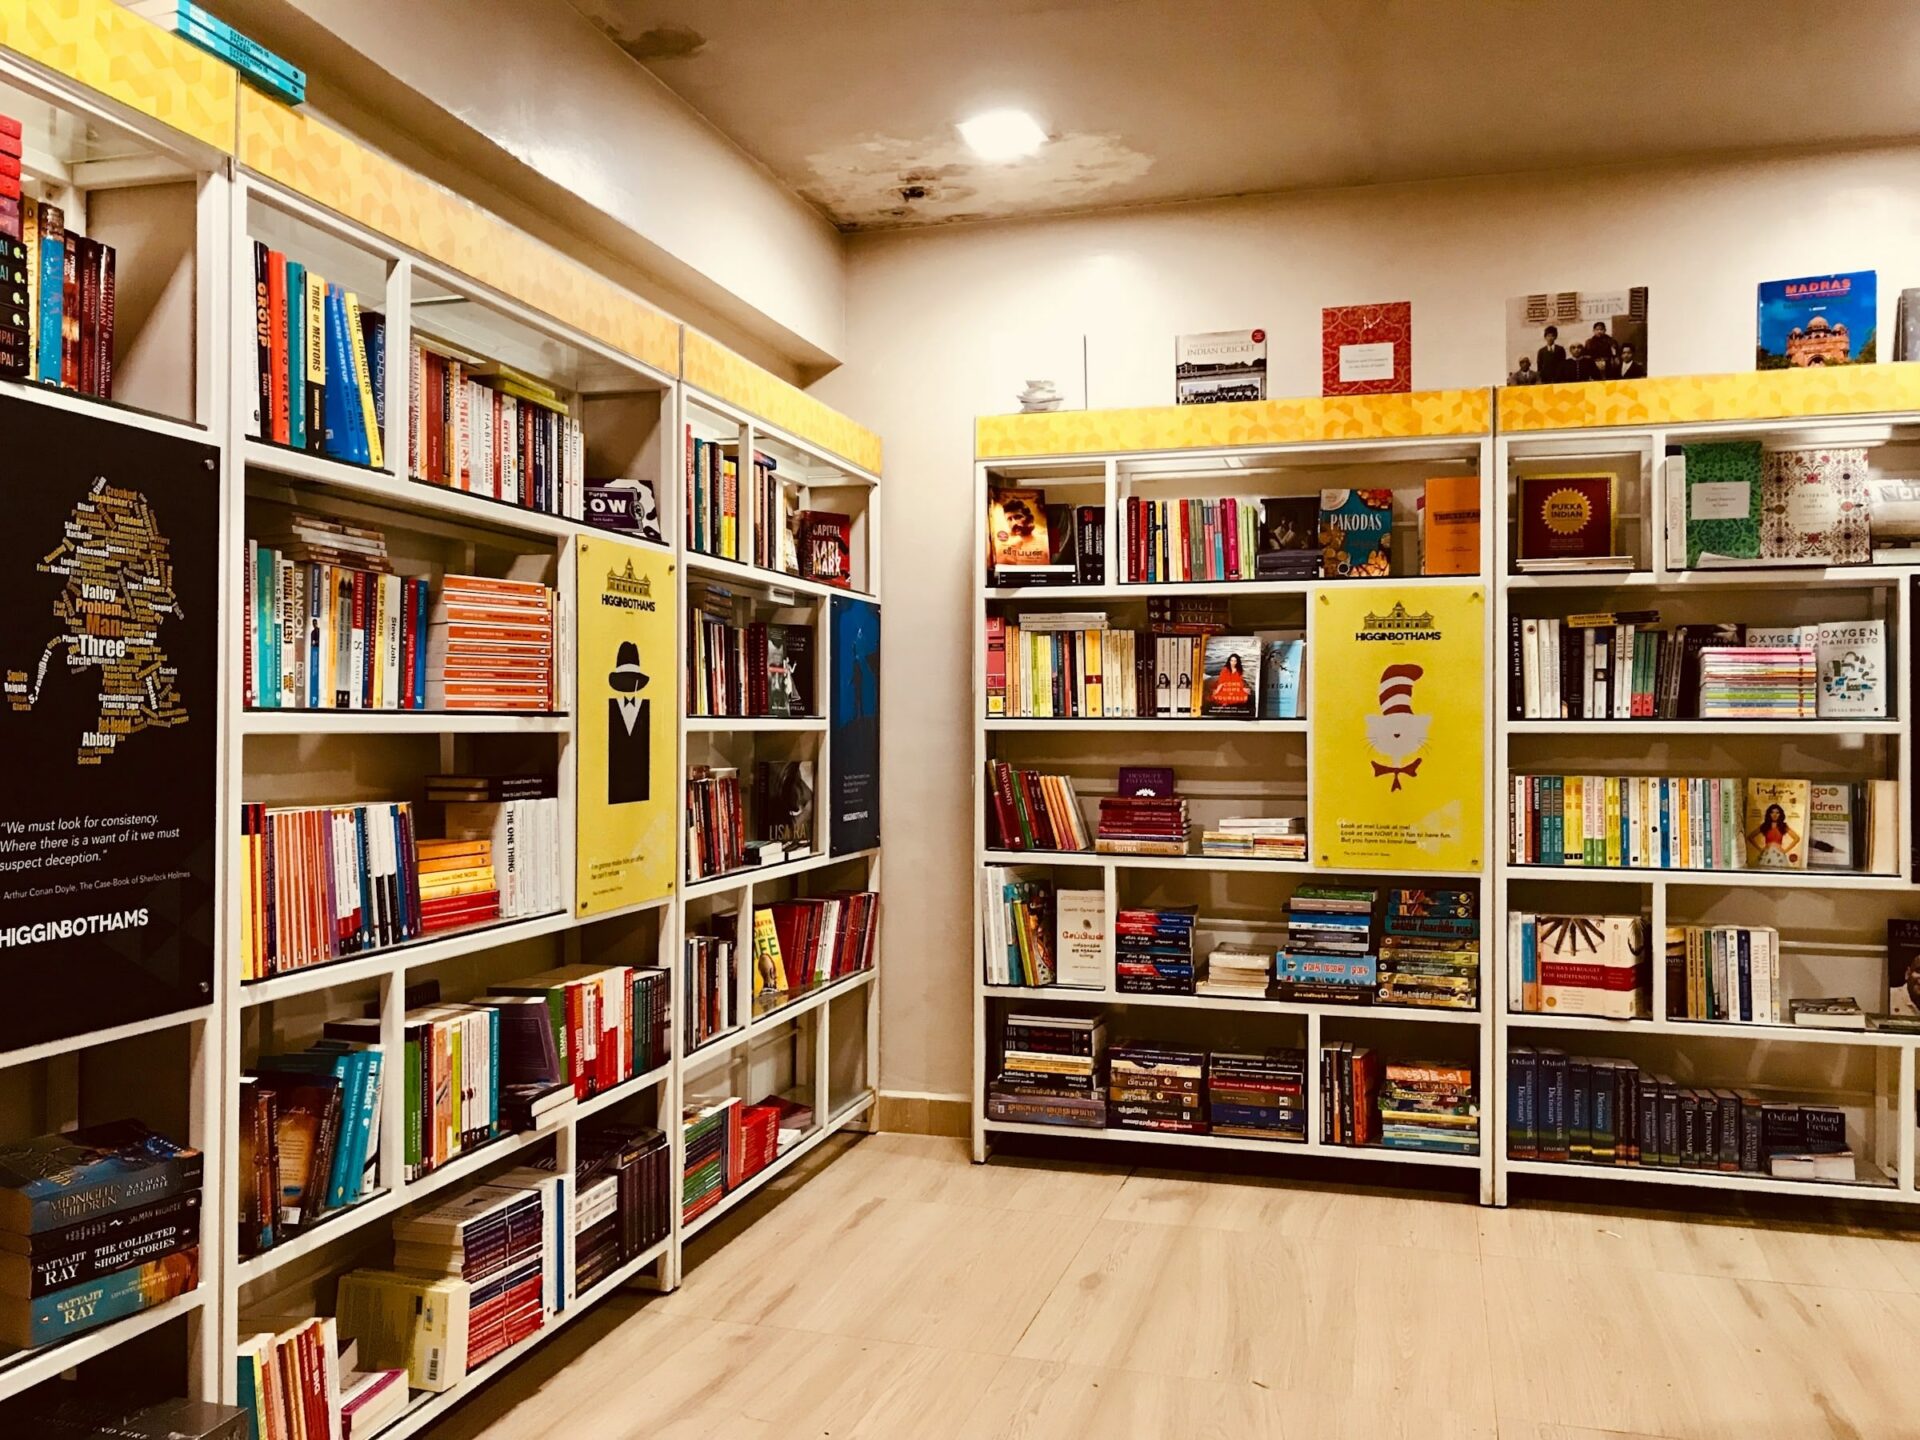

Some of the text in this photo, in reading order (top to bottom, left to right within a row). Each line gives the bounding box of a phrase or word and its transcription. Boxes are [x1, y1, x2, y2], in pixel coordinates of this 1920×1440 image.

[311, 284, 320, 311] TRIBE
[1785, 278, 1852, 295] MADRAS
[257, 281, 267, 348] GROUP
[333, 313, 343, 339] LEAN
[311, 325, 321, 372] MENTORS
[352, 304, 371, 396] GAME CHANGERS
[1187, 346, 1219, 356] INDIAN
[337, 339, 348, 384] STARTUP
[375, 323, 385, 422] The 10-Day MBA
[584, 498, 627, 514] OW
[1551, 503, 1583, 511] PUKKA
[1330, 513, 1382, 531] PAKODAS
[812, 539, 841, 557] KARL
[812, 557, 842, 577] MARX
[82, 583, 117, 603] Valley
[283, 565, 293, 601] WORK
[75, 598, 122, 617] Problem
[295, 571, 303, 639] BRANSON
[601, 594, 656, 612] HIGGINBOTHAMS
[1179, 600, 1214, 611] YOGI
[86, 613, 121, 637] Man
[1179, 612, 1214, 623] YOGI
[1355, 632, 1442, 641] HIGGINBOTHAMS
[1821, 628, 1878, 638] OXYGEN
[1821, 637, 1879, 646] MANIFESTO
[78, 634, 126, 657] Three
[1512, 616, 1521, 677] GENE MACHINE
[66, 654, 92, 667] Circle
[82, 732, 116, 748] Abbey
[28, 820, 56, 832] must
[57, 816, 82, 830] look
[84, 815, 100, 829] for
[101, 813, 159, 827] consistency.
[769, 824, 789, 841] LISA
[0, 828, 180, 852] Where there is a want of it we must
[0, 857, 42, 872] suspect
[507, 847, 515, 873] THING
[3, 870, 191, 900] Arthur Conan Doyle, The Case-Book of Sherlock Holmes
[0, 908, 149, 948] HIGGINBOTHAMS
[1511, 1058, 1536, 1067] Oxford
[1541, 1058, 1566, 1067] Oxford
[1517, 1085, 1526, 1124] Dictionary
[1548, 1087, 1556, 1125] Dictionary
[1597, 1091, 1606, 1129] Dictionary
[1768, 1112, 1799, 1123] Oxford
[1806, 1113, 1839, 1125] Oxford
[1685, 1110, 1693, 1155] DICTIONARY
[1705, 1111, 1713, 1157] DICTIONARY
[127, 1174, 168, 1190] SALMAN
[94, 1226, 177, 1257] THE COLLECTED
[94, 1237, 176, 1270] SHORT STORIES
[37, 1250, 87, 1286] SATYAJIT RAY
[56, 1288, 104, 1324] SATYAJIT RAY
[312, 1368, 321, 1396] BIG
